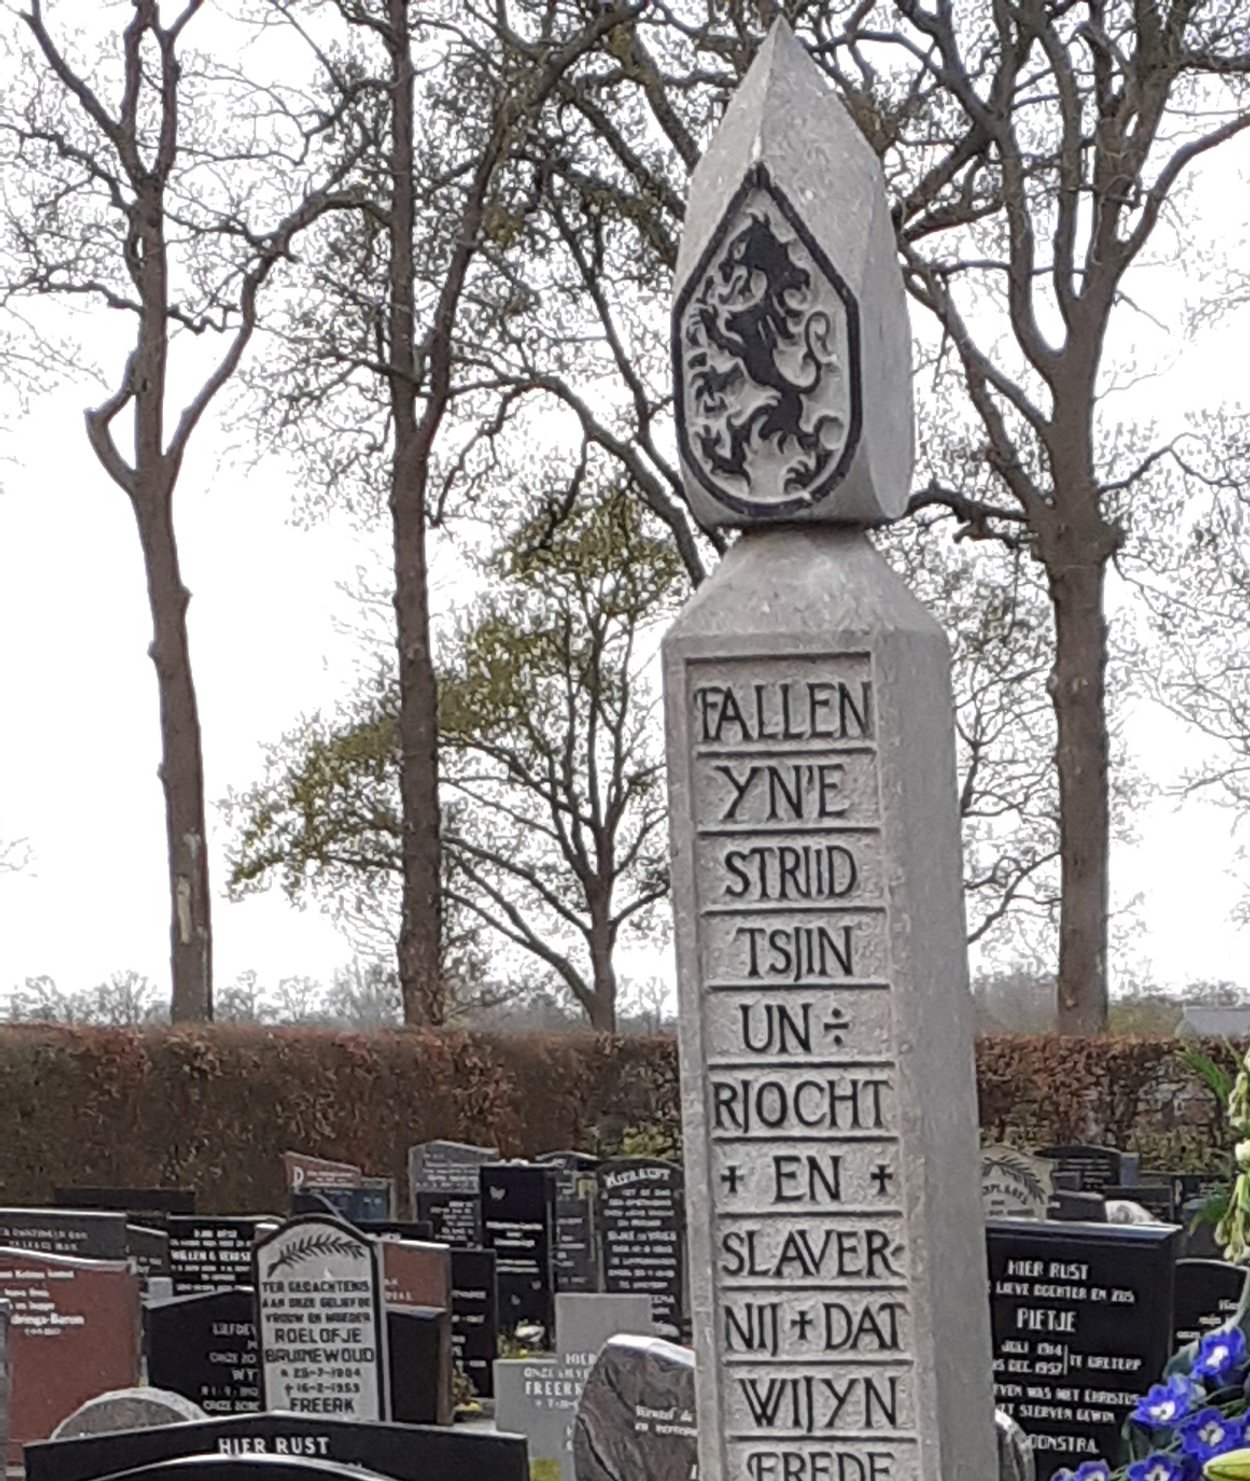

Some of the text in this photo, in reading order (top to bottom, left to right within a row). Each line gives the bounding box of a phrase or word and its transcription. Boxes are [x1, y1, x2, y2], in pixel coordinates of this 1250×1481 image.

[694, 681, 872, 740] FALLEN
[714, 764, 848, 821] YN'E
[724, 845, 857, 899] STRIID
[736, 925, 855, 982] TSJIN
[740, 1003, 813, 1053] UN
[712, 1079, 894, 1133] RJOCHT
[772, 1155, 841, 1203] EN
[1008, 1259, 1089, 1280] HIER RUST
[275, 1329, 362, 1343] ROELOFJE
[724, 1303, 910, 1356] NIJ DAT
[1017, 1308, 1077, 1332] PIETJE
[290, 1397, 355, 1413] FREERK
[219, 1437, 329, 1455] HIER RUST
